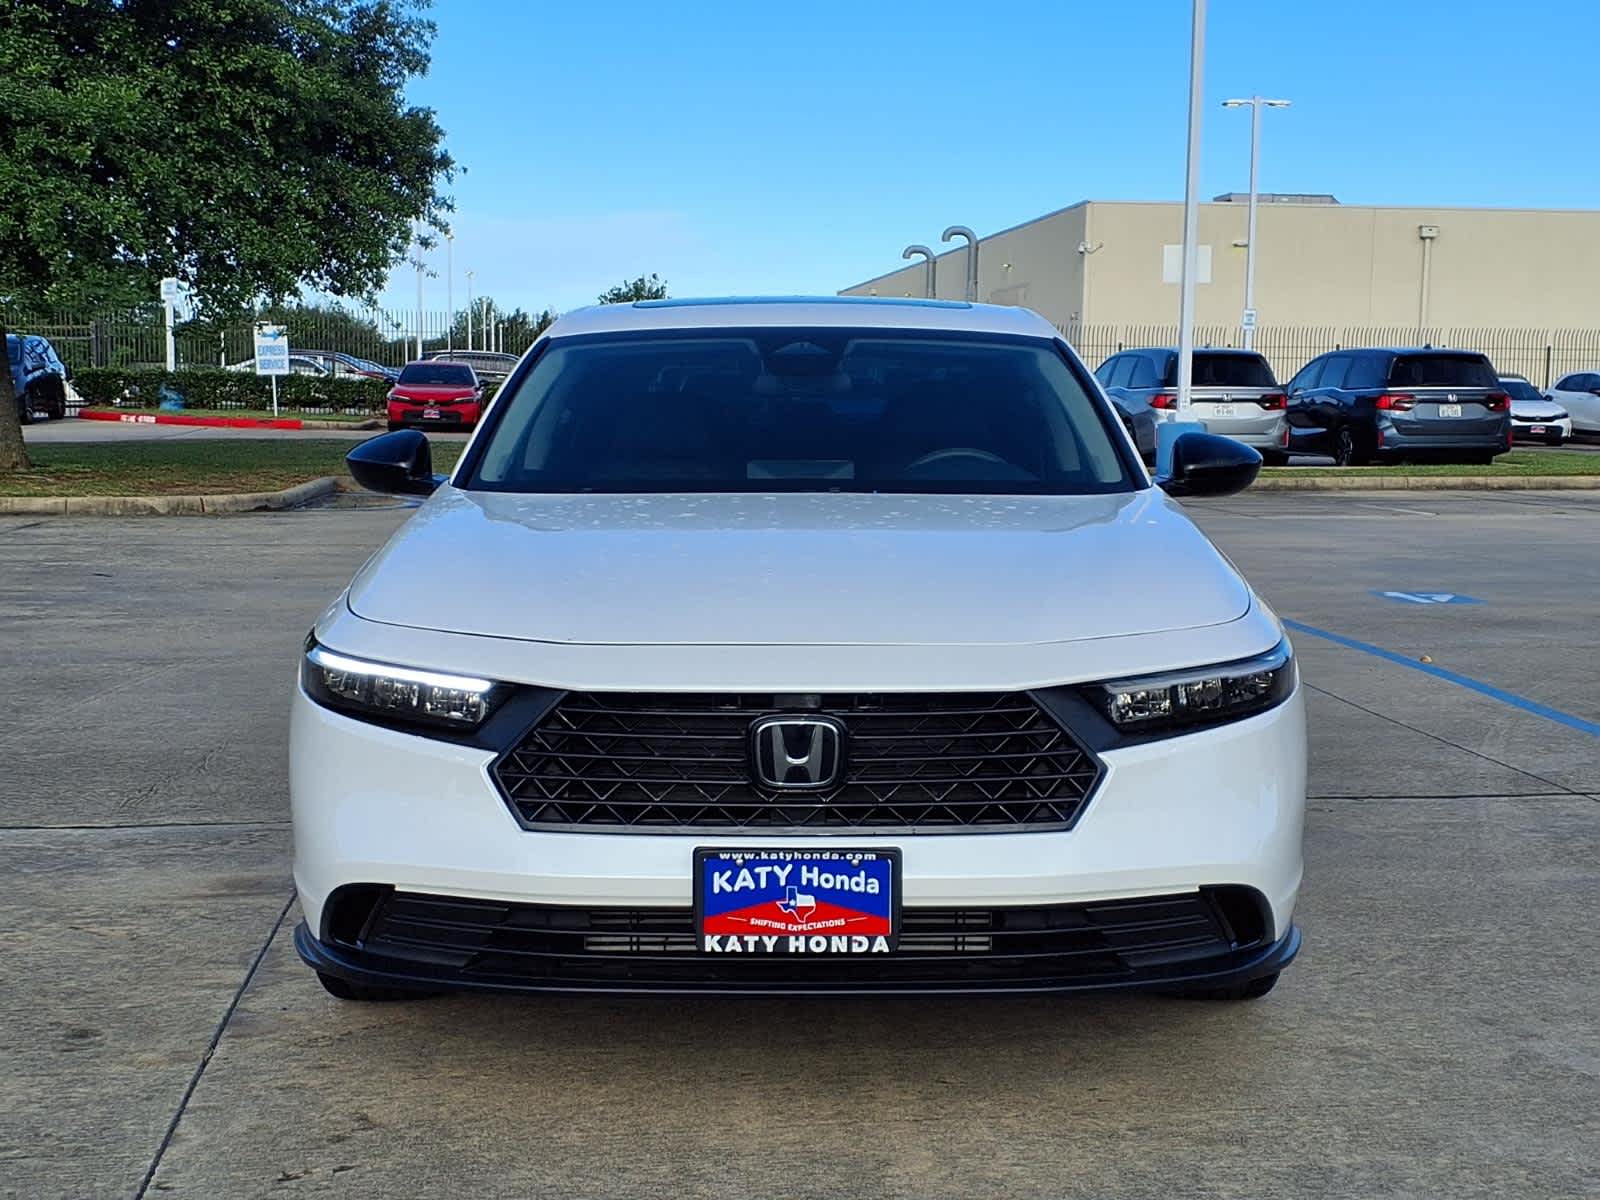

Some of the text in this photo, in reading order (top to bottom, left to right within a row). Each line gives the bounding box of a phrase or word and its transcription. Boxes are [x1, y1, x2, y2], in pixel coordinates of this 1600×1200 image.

[719, 851, 877, 862] www.katyhonda.com
[713, 863, 880, 895] KATY Honda
[749, 917, 846, 931] SHIFTING EXPECTATIONS
[704, 935, 890, 953] KATY HONDA
